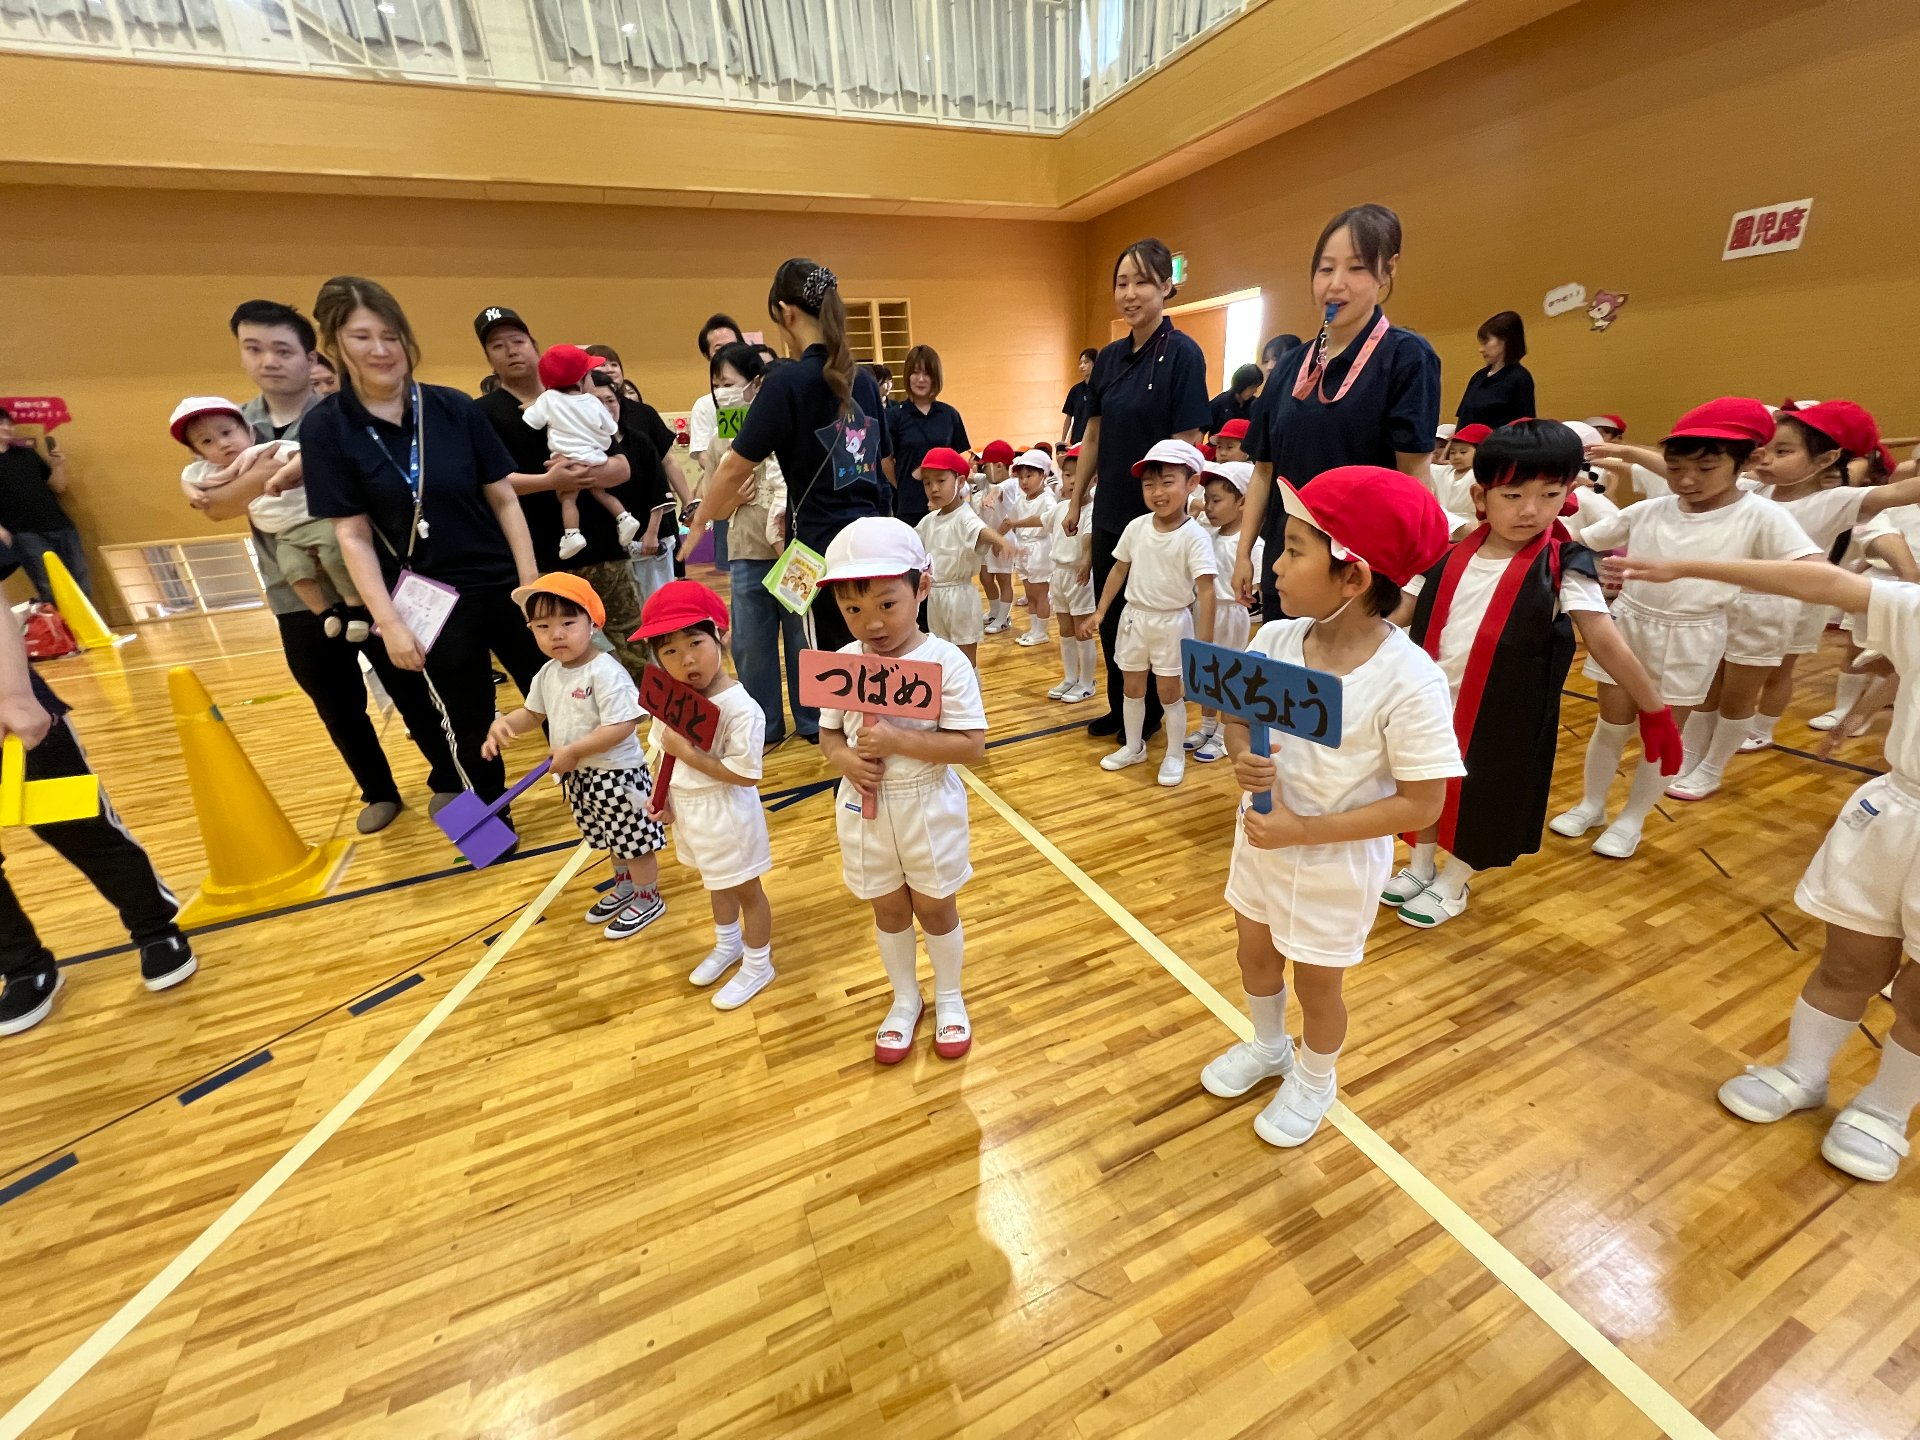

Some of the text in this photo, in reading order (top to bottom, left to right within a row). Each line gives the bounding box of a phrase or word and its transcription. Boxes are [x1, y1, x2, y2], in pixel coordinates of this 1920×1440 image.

[1728, 206, 1808, 251] 園児席
[485, 307, 502, 321] NY
[815, 663, 933, 709] つばめ
[1188, 653, 1328, 738] はくちょう
[645, 676, 707, 743] こばと
